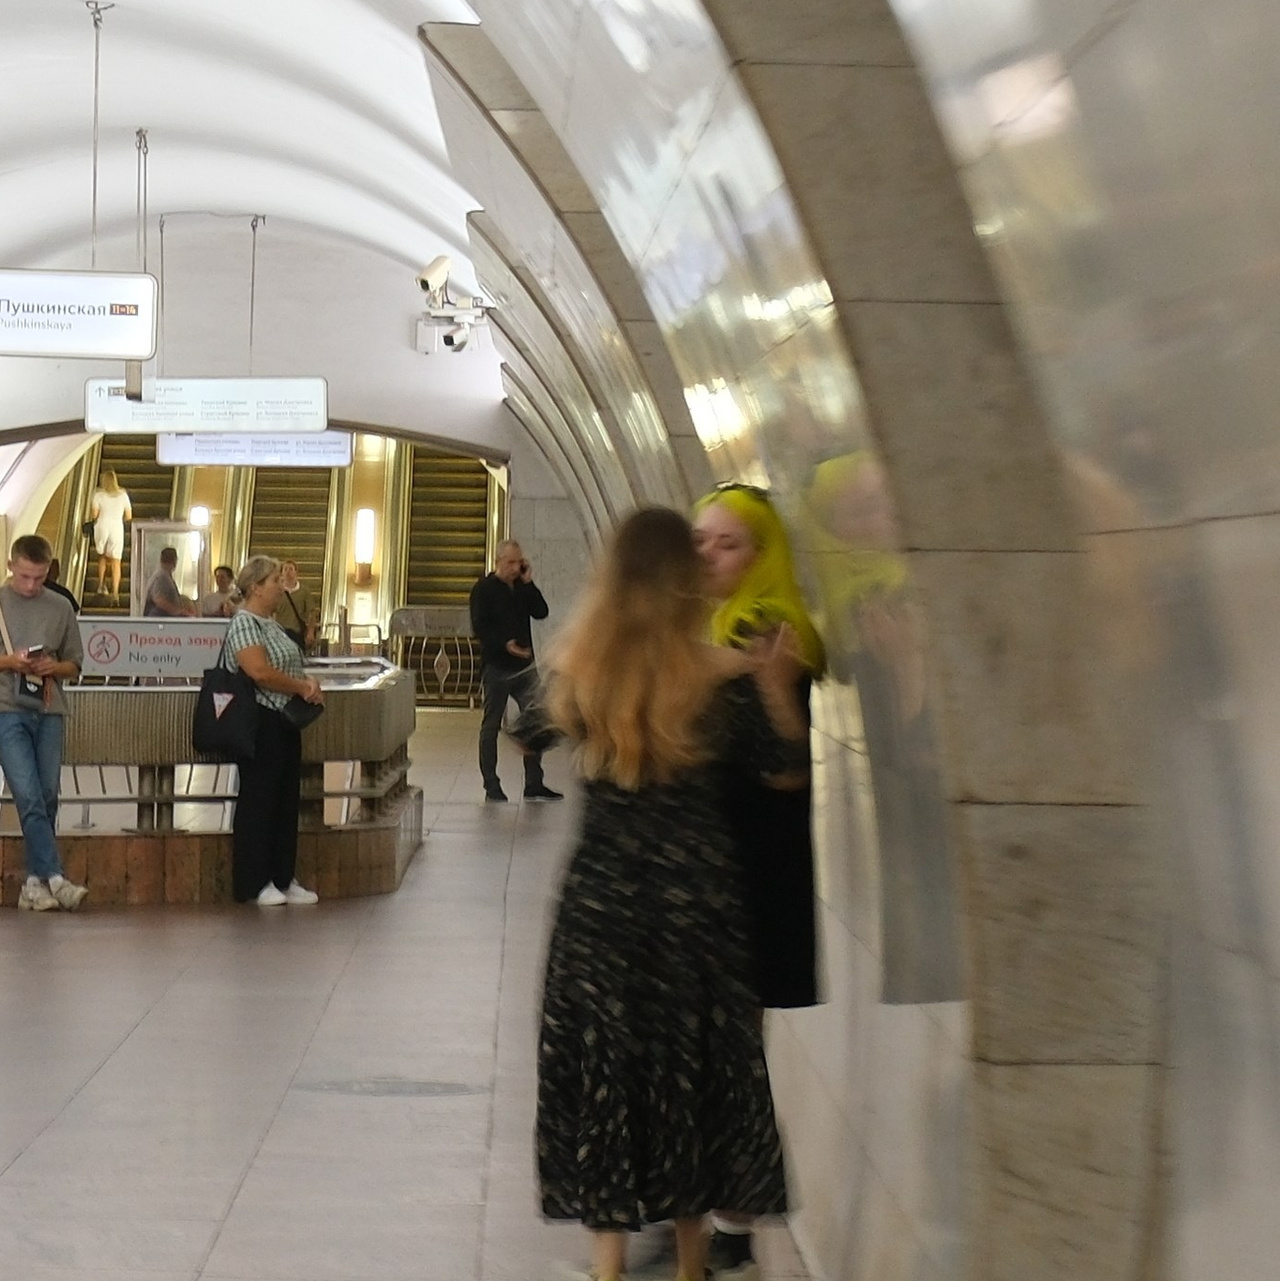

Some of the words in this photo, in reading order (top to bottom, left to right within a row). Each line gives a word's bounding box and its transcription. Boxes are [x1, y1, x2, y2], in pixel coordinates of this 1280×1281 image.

[129, 633, 182, 646] Проход
[129, 652, 148, 663] No
[152, 652, 182, 665] entry
